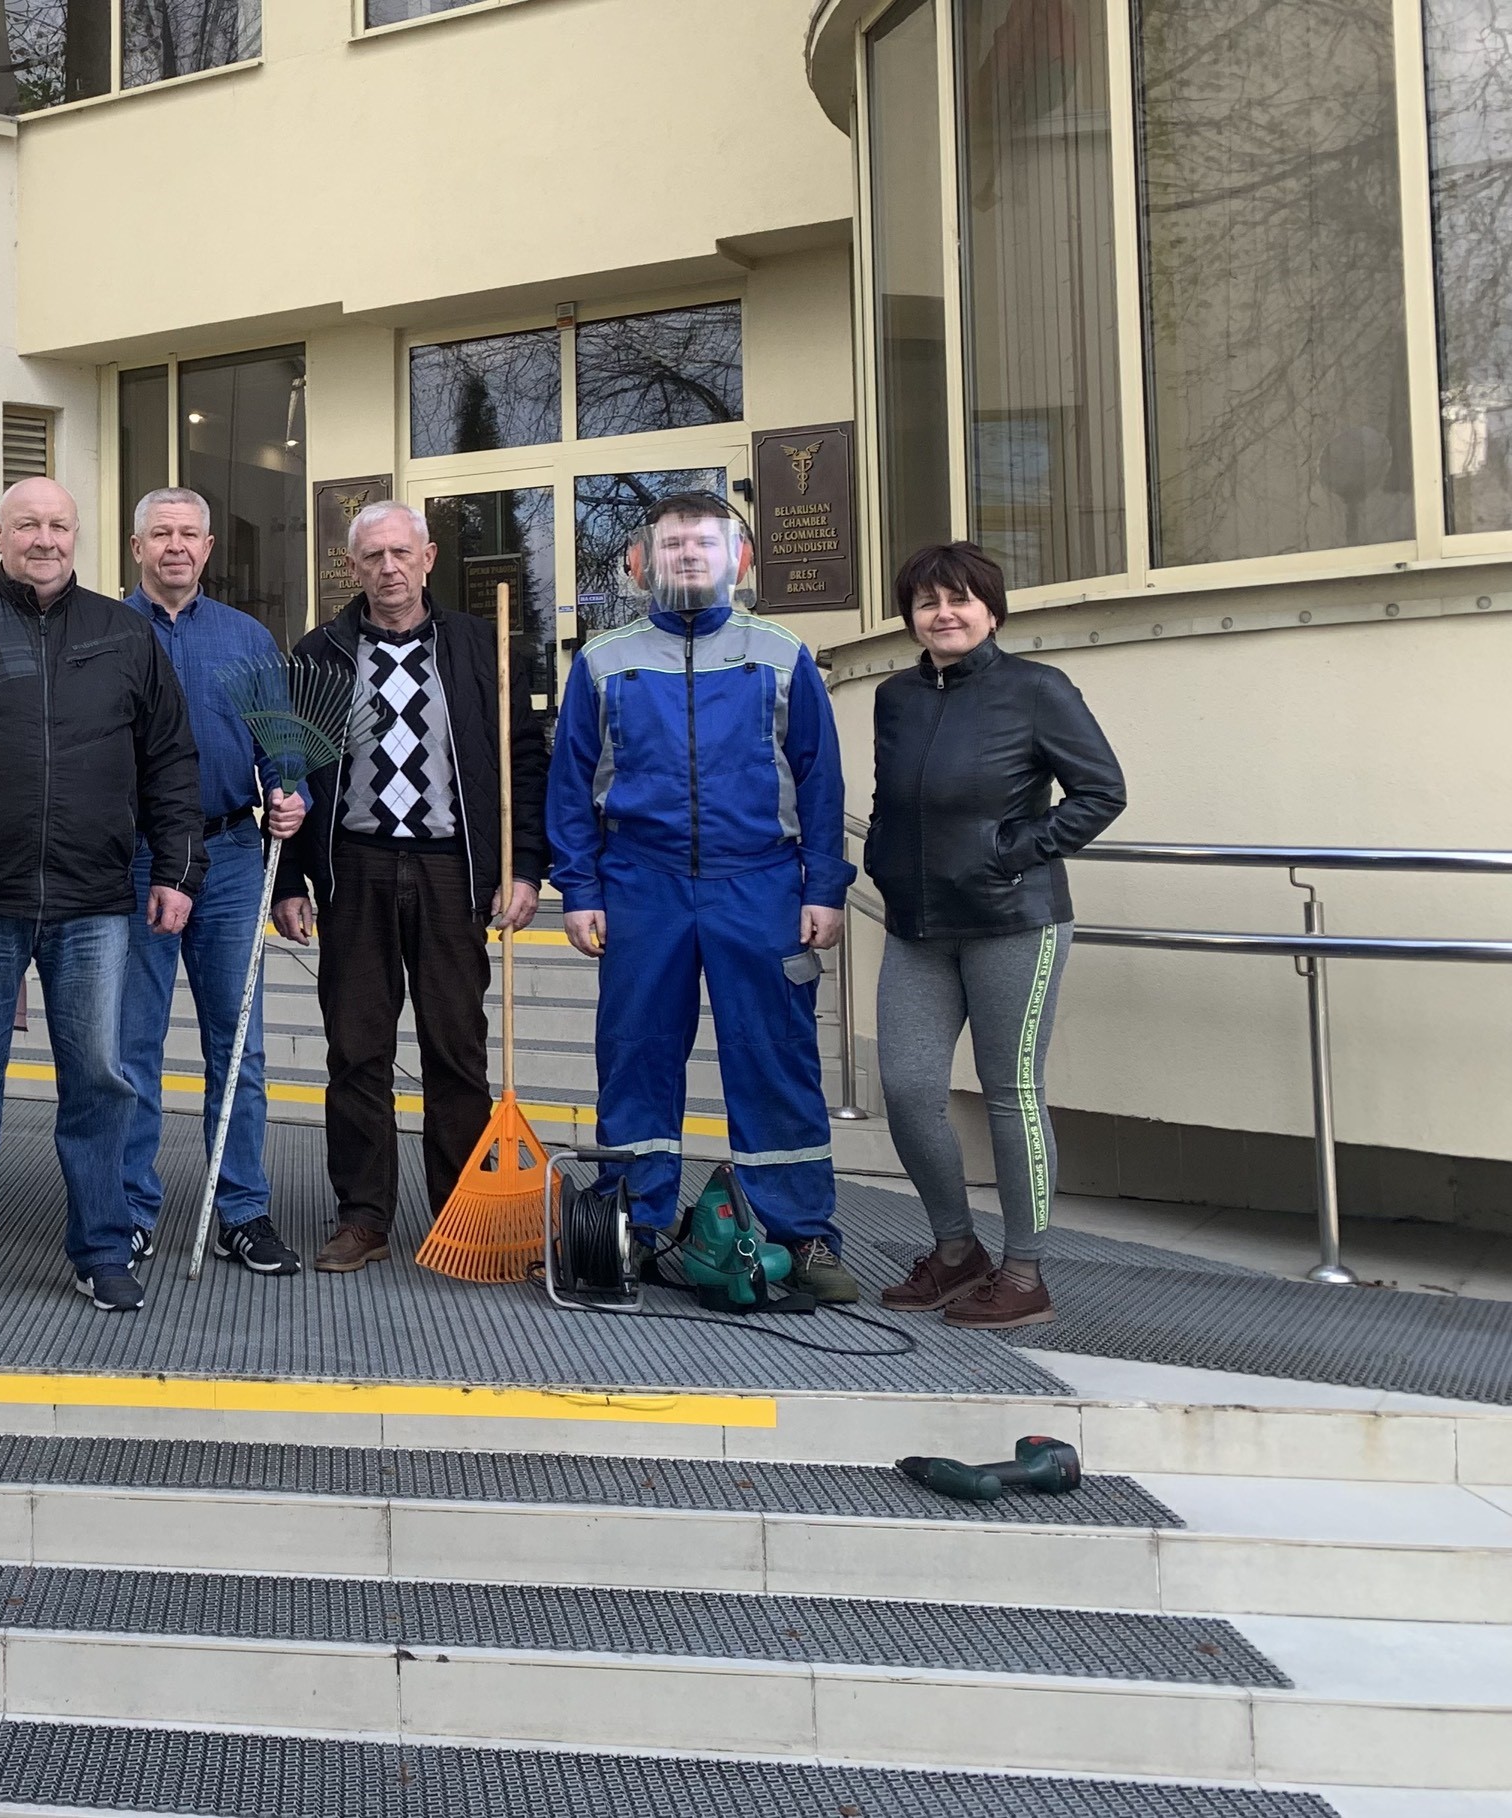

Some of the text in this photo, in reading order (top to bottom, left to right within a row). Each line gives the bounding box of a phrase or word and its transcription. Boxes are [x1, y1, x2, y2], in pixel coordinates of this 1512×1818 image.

[774, 503, 831, 517] BELARUSIAN
[782, 516, 828, 528] CHAMBER
[771, 528, 837, 542] OF COMMERCE
[773, 540, 839, 554] AND INDUSTRY
[787, 581, 825, 593] BRANCH
[790, 569, 818, 580] BREST
[1041, 939, 1053, 975] SPORTS
[1031, 980, 1045, 1014] SPORTS
[1023, 1019, 1035, 1052] SPORTS
[1022, 1056, 1031, 1089] SPORTS
[1023, 1090, 1036, 1122] SPORTS
[1030, 1126, 1042, 1160] SPORTS
[1035, 1164, 1045, 1196] SPORTS
[1037, 1200, 1046, 1232] SPORTS
